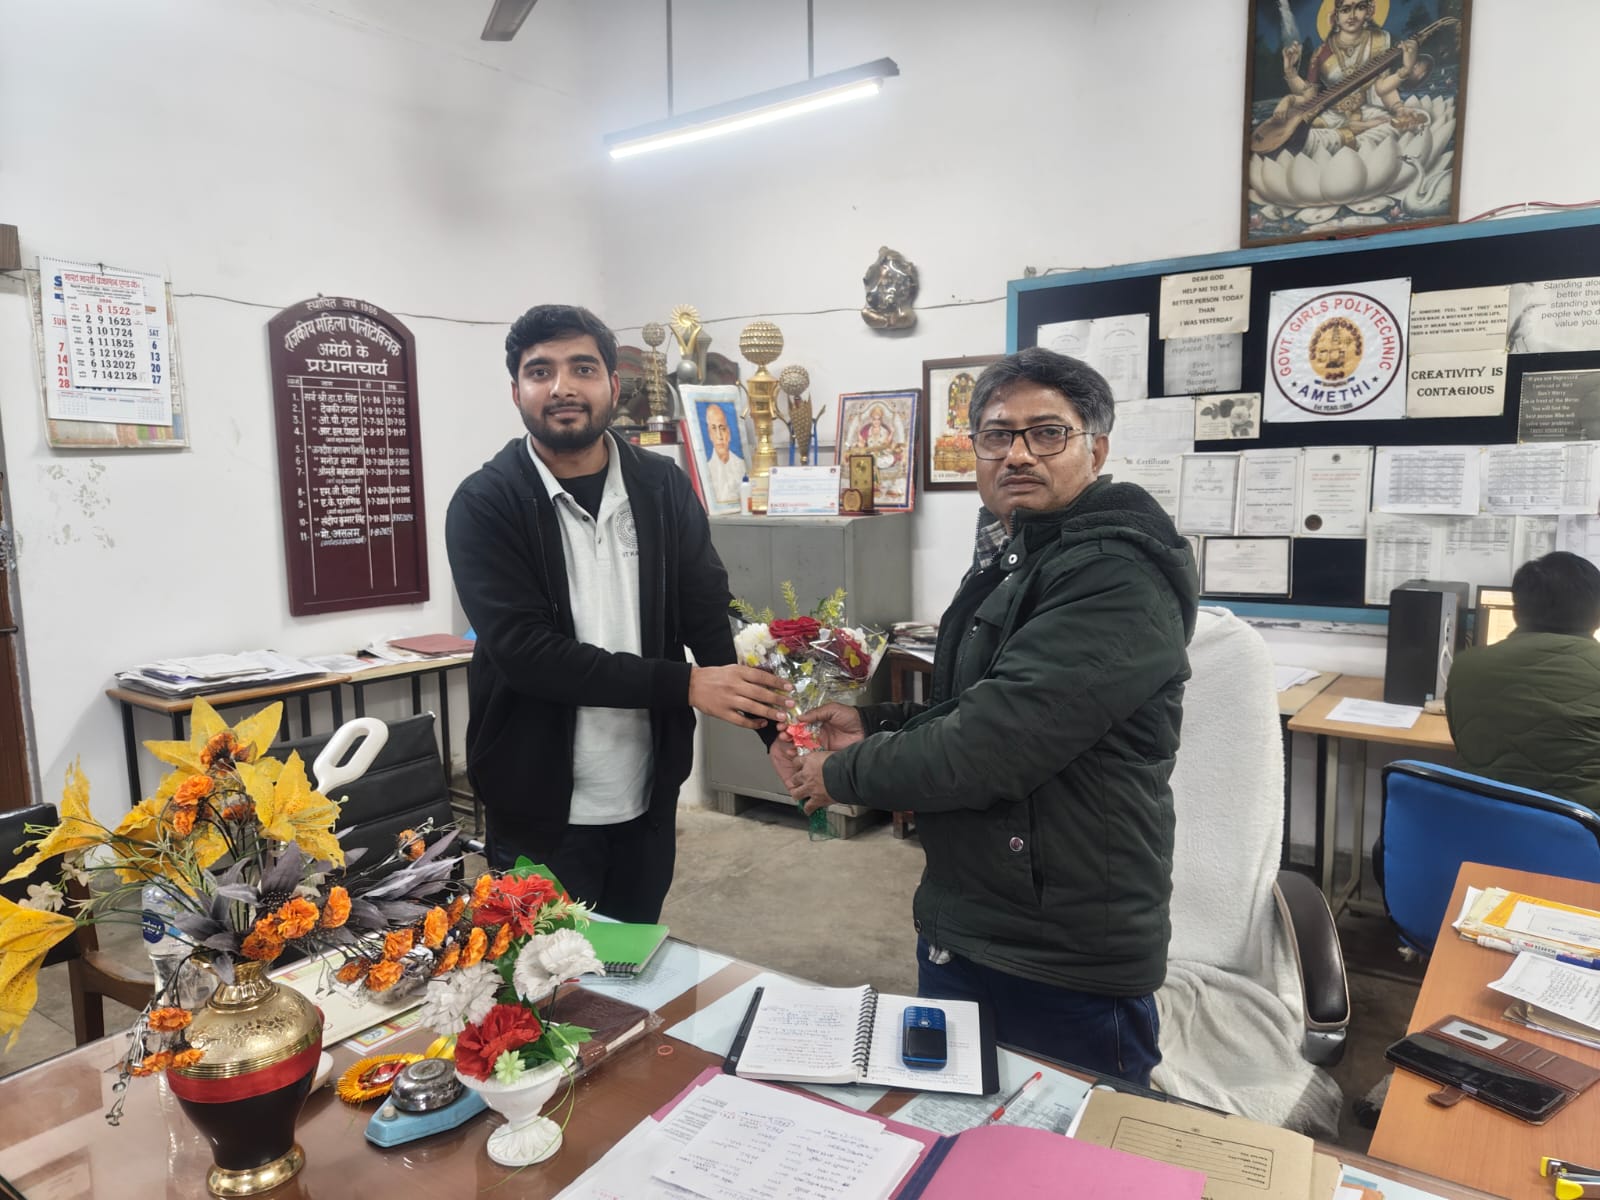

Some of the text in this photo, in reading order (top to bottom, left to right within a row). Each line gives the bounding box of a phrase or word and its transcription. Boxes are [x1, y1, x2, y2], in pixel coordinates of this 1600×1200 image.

[1544, 281, 1582, 290] Standing
[1222, 294, 1244, 302] TODAY
[1556, 290, 1582, 298] better
[1551, 300, 1588, 308] standing
[85, 304, 90, 312] 1
[97, 304, 103, 314] 8
[108, 306, 118, 314] 15
[120, 306, 130, 315] 22
[85, 315, 92, 323] 2
[98, 316, 104, 324] 9
[109, 317, 119, 325] 16
[121, 317, 132, 326] 23
[1199, 316, 1233, 325] YESTERDAY
[1541, 311, 1571, 320] people
[53, 317, 67, 326] SUN
[87, 326, 132, 337] 3 10 17 24
[285, 320, 316, 352] राजकीय
[315, 312, 346, 335] महिला
[88, 337, 134, 348] 4 11 18 25
[1278, 298, 1396, 377] GOVT. GIRLS POLYTECHNIC
[59, 342, 64, 351] 7
[152, 341, 157, 350] 6
[318, 338, 369, 358] अमेठी के
[90, 348, 95, 357] 5
[100, 349, 110, 357] 12
[113, 350, 123, 358] 19
[151, 352, 160, 361] 13
[58, 354, 68, 364] 14
[91, 359, 136, 369] 6 13 20 27
[58, 366, 68, 376] 21
[151, 364, 160, 372] 20
[305, 359, 388, 376] प्रधानाचार्य
[92, 370, 137, 380] 7 14 21 28
[1411, 366, 1504, 380] CREATIVITY IS
[58, 378, 70, 388] 28
[152, 375, 161, 384] 27
[1298, 379, 1371, 403] AMETHI
[1417, 386, 1494, 397] CONTAGIOUS
